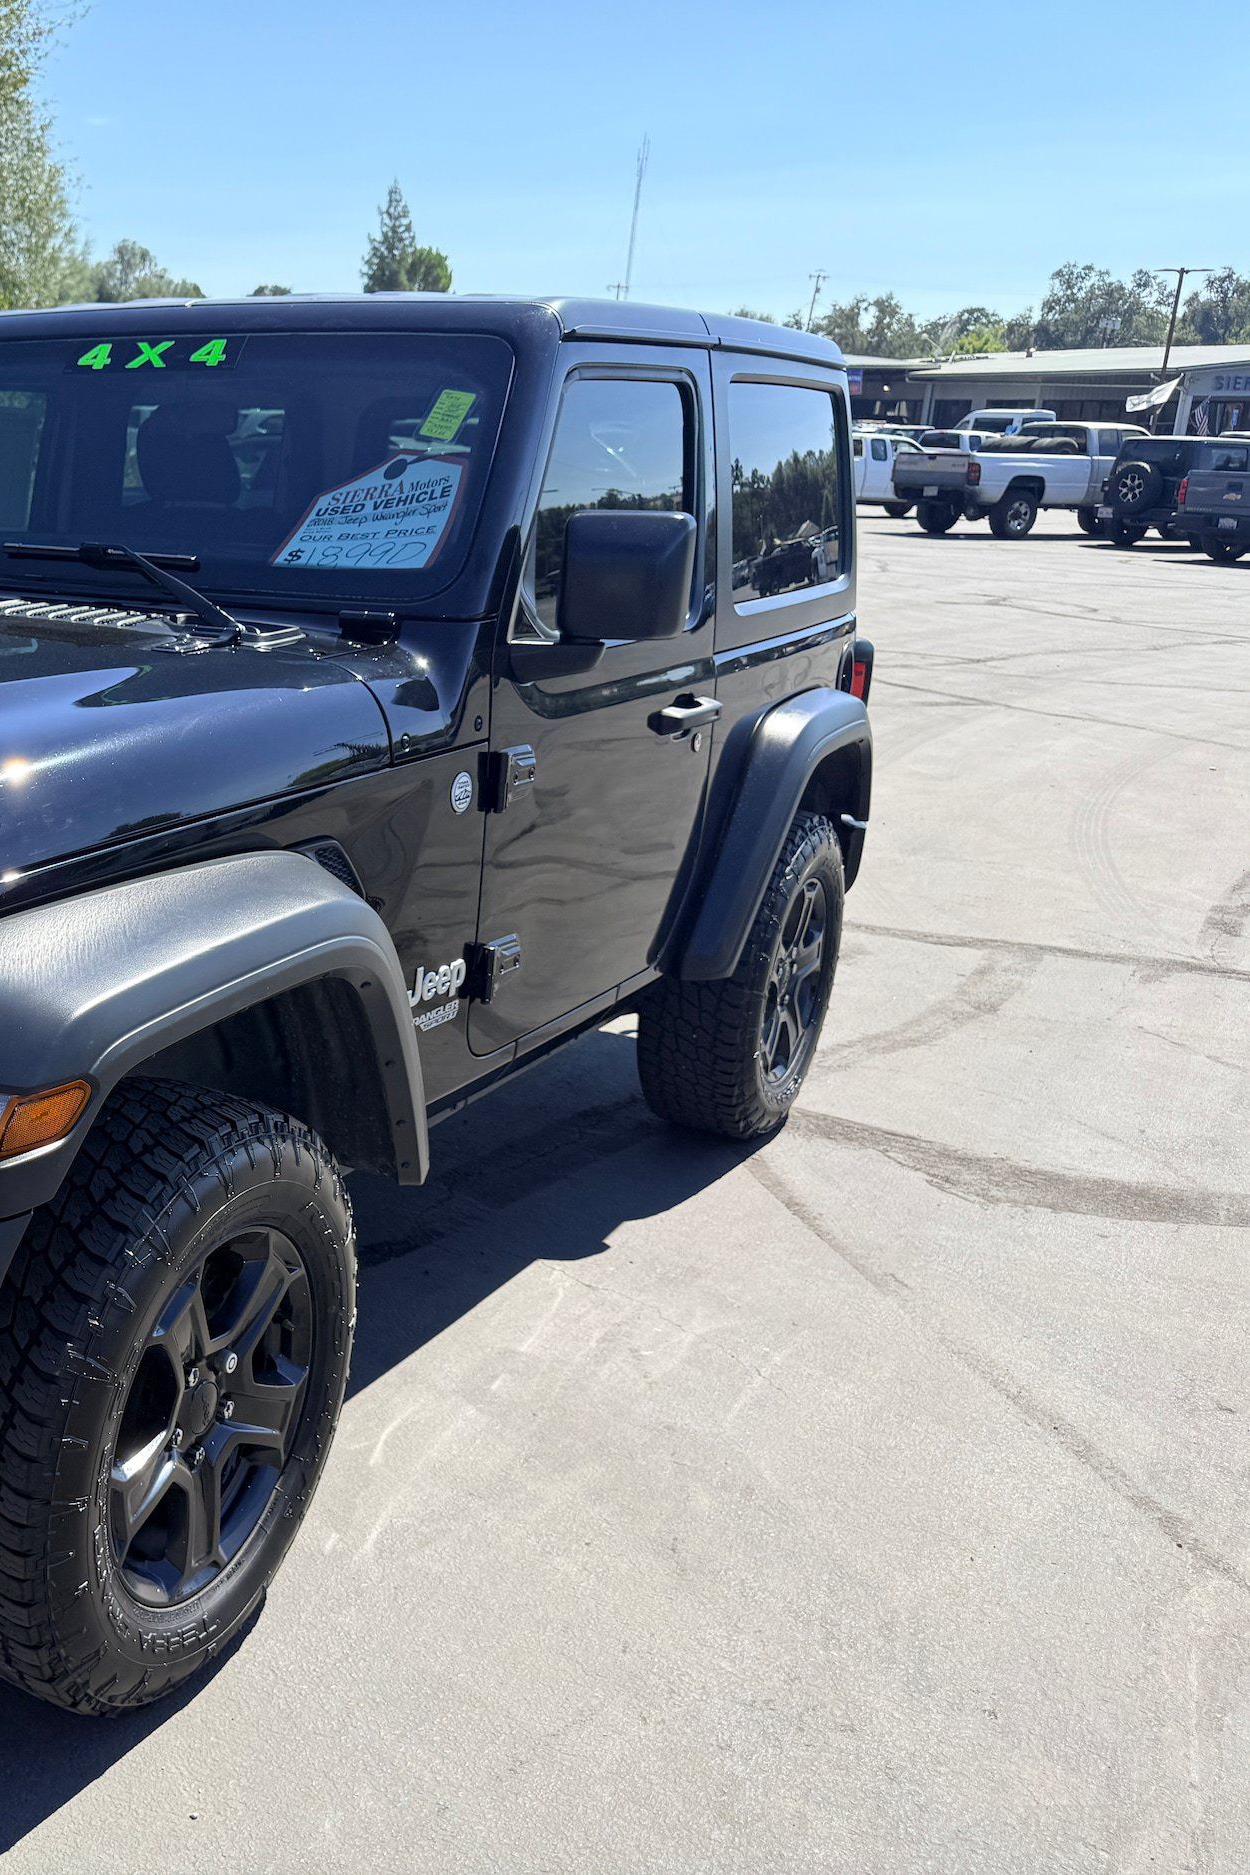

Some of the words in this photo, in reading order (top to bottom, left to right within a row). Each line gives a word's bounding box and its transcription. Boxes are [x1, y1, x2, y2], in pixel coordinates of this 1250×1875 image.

[315, 502, 365, 517] USED
[372, 485, 453, 511] VEHICLE
[327, 479, 405, 506] SIERRA
[408, 476, 451, 493] Motors
[338, 514, 367, 527] Jeep
[372, 507, 417, 526] Wrangler
[418, 502, 448, 518] Sport
[300, 534, 333, 543] OUR
[337, 531, 382, 541] BEST
[383, 525, 437, 539] PRICE
[407, 958, 466, 1007] Jeep
[412, 999, 459, 1027] RANGLER
